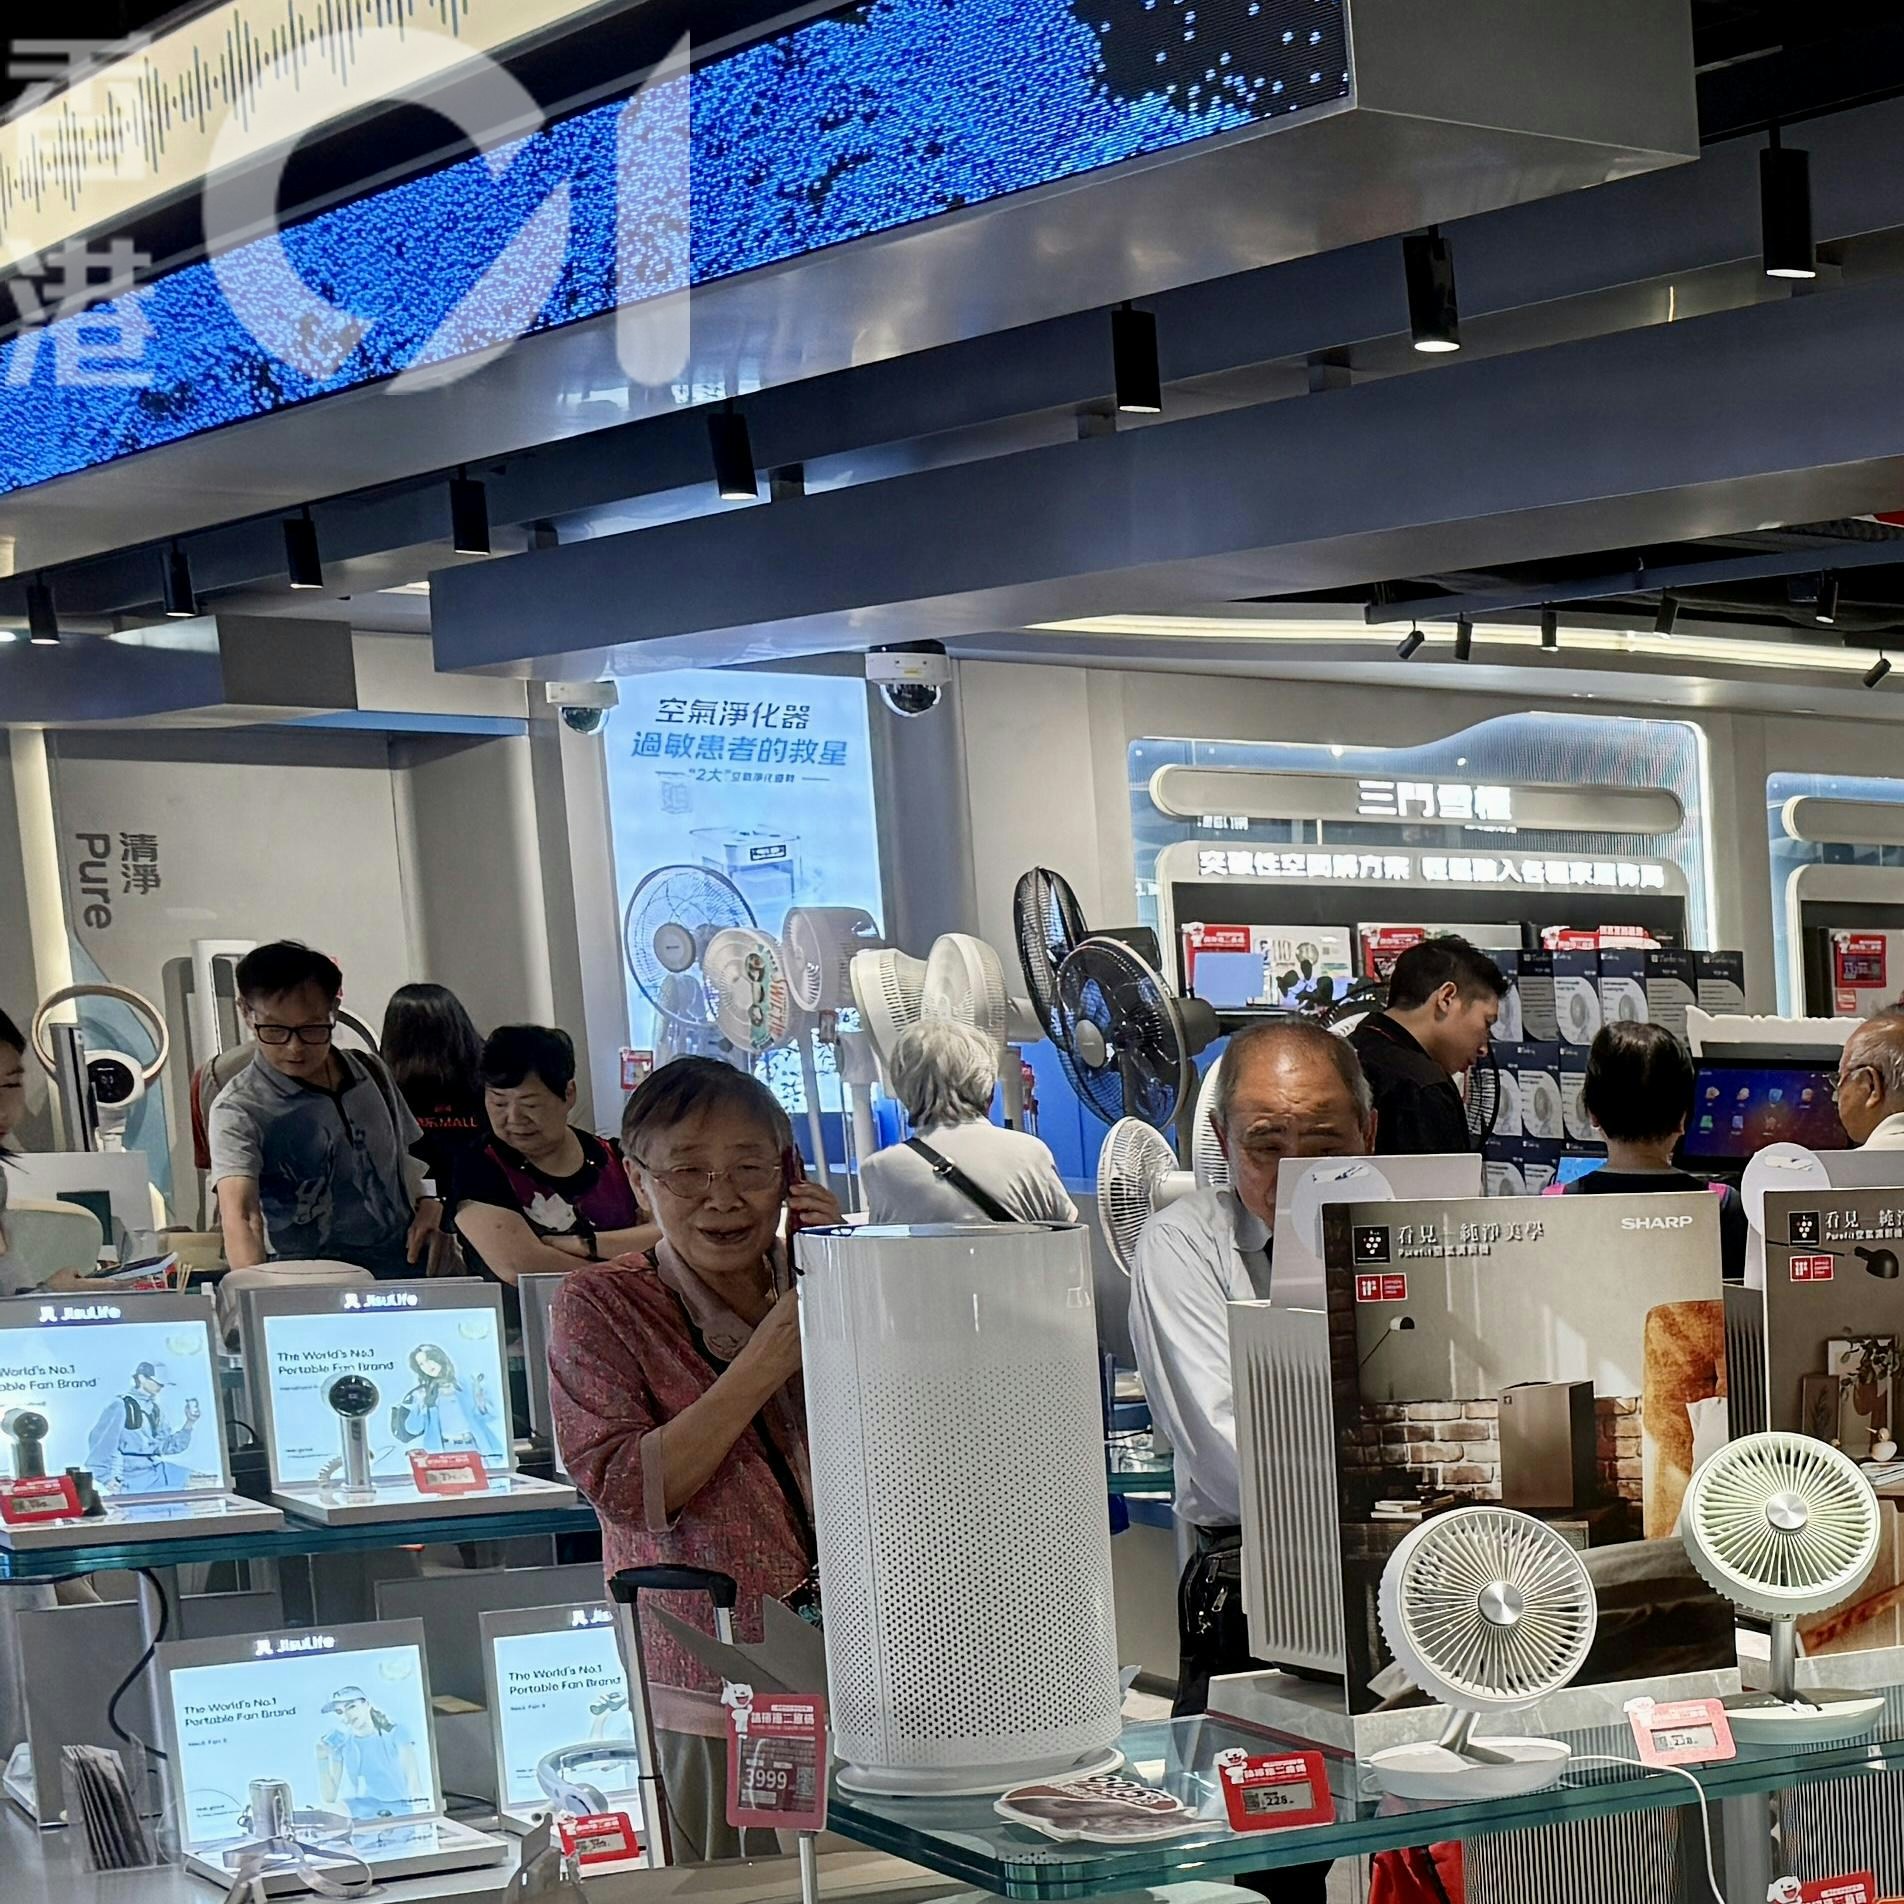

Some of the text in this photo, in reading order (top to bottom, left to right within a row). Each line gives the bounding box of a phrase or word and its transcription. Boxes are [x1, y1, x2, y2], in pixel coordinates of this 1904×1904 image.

[655, 697, 811, 730] 空氣淨化器
[631, 730, 849, 767] 過敏患者的救星
[119, 830, 162, 897] 清淨
[75, 831, 115, 931] Pure
[1620, 1214, 1694, 1231] SHARP
[29, 1376, 98, 1391] Fan Brand
[744, 1766, 788, 1790] 3999
